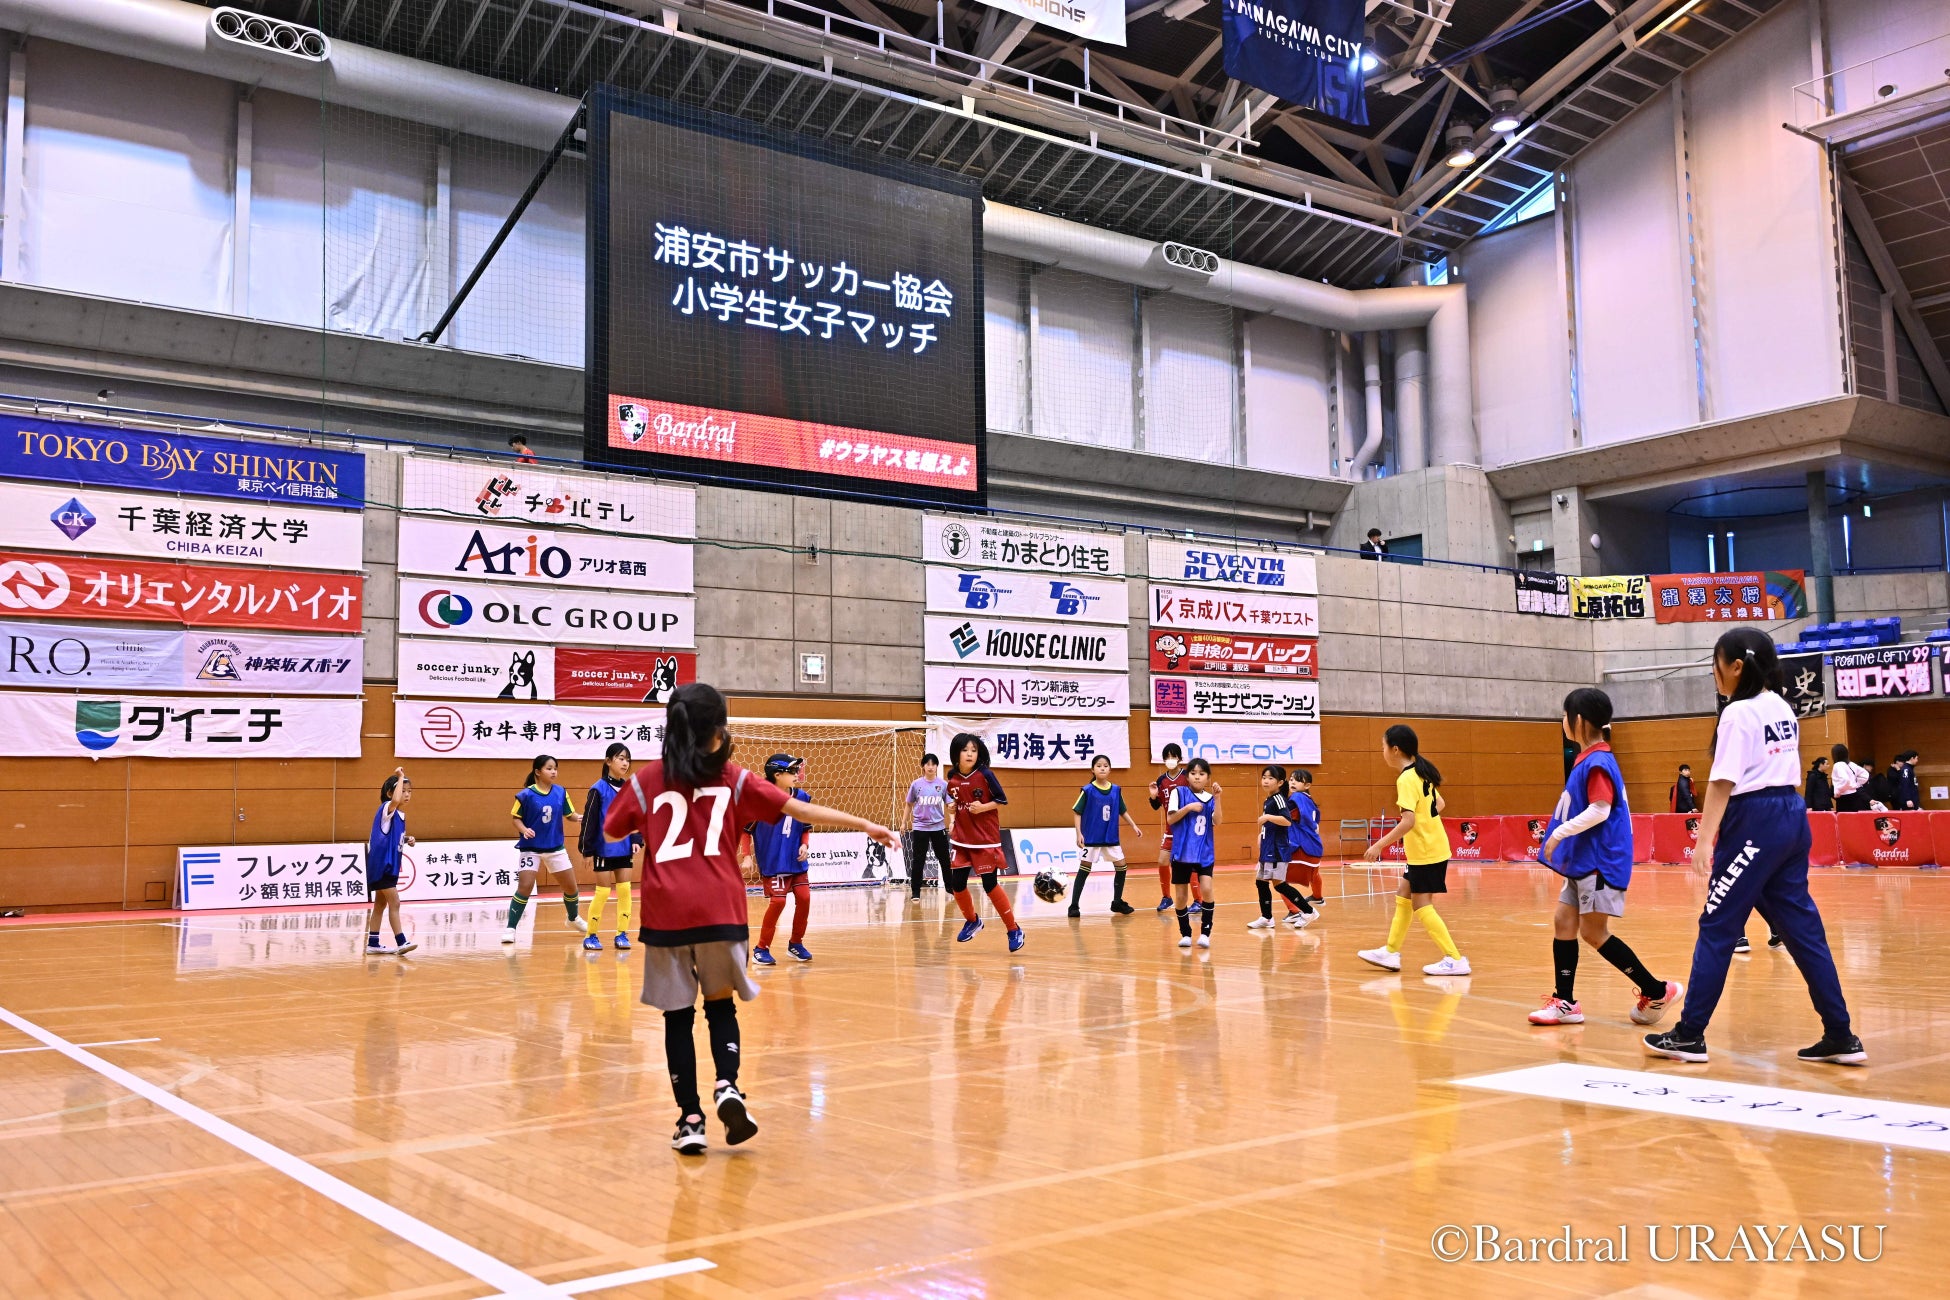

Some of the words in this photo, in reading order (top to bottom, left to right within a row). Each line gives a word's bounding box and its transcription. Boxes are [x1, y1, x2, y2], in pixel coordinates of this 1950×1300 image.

[1258, 27, 1301, 51] FUTSAL
[1306, 46, 1332, 63] CLUB
[1324, 34, 1362, 59] CITY
[654, 222, 953, 318] 浦安市サッカー協会
[672, 276, 938, 354] 小学生女子マッチ
[653, 413, 737, 444] Bardral
[657, 435, 733, 453] URAYASU
[17, 430, 129, 464] TOKYO
[213, 451, 339, 485] SHINKIN
[237, 478, 339, 500] 東京ベイ信用金庫
[58, 511, 87, 527] CK
[118, 506, 309, 543] 千葉経済大学
[166, 540, 212, 554] CHIBA
[216, 544, 263, 558] KEIZAI
[455, 530, 572, 579] Ario
[1001, 538, 1109, 572] かまとり住宅
[579, 557, 647, 577] アリオ葛西
[1186, 550, 1285, 571] SEVENTH
[1184, 565, 1257, 585] PLACE
[1556, 575, 1567, 592] 18
[1627, 578, 1643, 594] 12
[82, 571, 357, 621] オリエンタルバイオ
[1574, 595, 1644, 618] 上原拓也
[483, 602, 552, 627] OLC
[565, 608, 679, 633] GROUP
[1179, 597, 1247, 624] 京成バス
[1249, 609, 1314, 626] 千葉ウエスト
[9, 635, 92, 676] R.O.
[986, 628, 1046, 659] HOUSE
[1049, 634, 1107, 661] CLINIC
[1189, 641, 1312, 663] 車検のコバック
[1912, 646, 1930, 662] 99
[244, 656, 351, 674] 神楽坂スポーツ
[417, 661, 458, 673] soccer
[462, 663, 500, 676] junky
[571, 669, 608, 679] soccer
[611, 670, 645, 681] junky
[1021, 679, 1079, 693] イオン新浦安
[1157, 682, 1185, 700] 学生
[1021, 693, 1115, 707] ショッピングセンター
[1193, 690, 1315, 714] 学生ナビステーション
[128, 706, 283, 743] ダイニチ
[472, 719, 562, 742] 和牛専門
[997, 732, 1094, 761] 明海大学
[541, 805, 552, 824] 3
[1102, 804, 1111, 822] 6
[652, 786, 732, 864] 27
[1194, 815, 1207, 836] 8
[426, 853, 477, 865] 和牛専門
[520, 856, 534, 869] 55
[829, 849, 858, 860] junky
[1082, 848, 1089, 858] 2
[1873, 848, 1909, 859] Bardral
[237, 853, 363, 879] フレックス
[238, 879, 365, 901] 少額短期保険
[1706, 845, 1761, 915] ATHLETA
